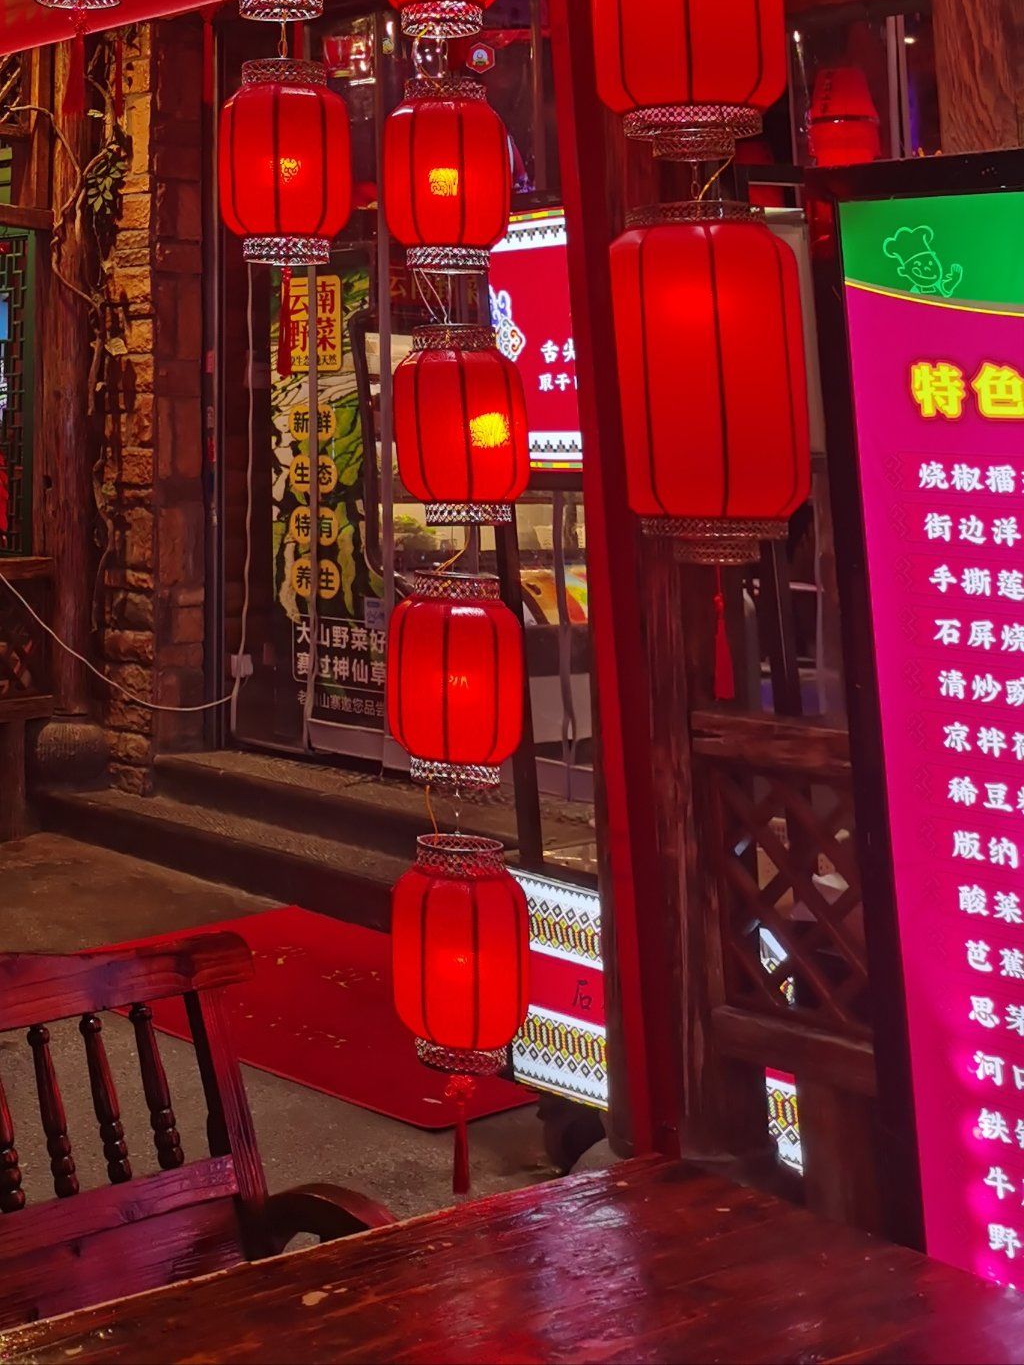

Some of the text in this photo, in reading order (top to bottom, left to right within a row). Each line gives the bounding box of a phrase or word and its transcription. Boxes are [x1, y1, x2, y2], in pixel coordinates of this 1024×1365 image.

[288, 280, 337, 315] 云南
[288, 317, 337, 353] 野菜
[538, 372, 578, 391] 取于
[912, 363, 1024, 418] 特色
[293, 410, 332, 434] 新鲜
[294, 462, 333, 485] 生态
[919, 461, 1024, 494] 烧椒擂
[295, 513, 333, 538] 特有
[924, 513, 1022, 547] 街边洋
[296, 565, 336, 591] 养生
[929, 565, 1024, 601] 手撕莲
[296, 621, 387, 655] 大山野菜好
[934, 619, 1024, 652] 石屏烧
[297, 690, 385, 717] 老山寨邀您品尝
[947, 776, 1024, 814] 稀豆
[952, 831, 1019, 870] 版纳
[958, 884, 1024, 924] 酸菜
[965, 940, 1024, 980] 芭蕉
[984, 1167, 1024, 1205] 牛
